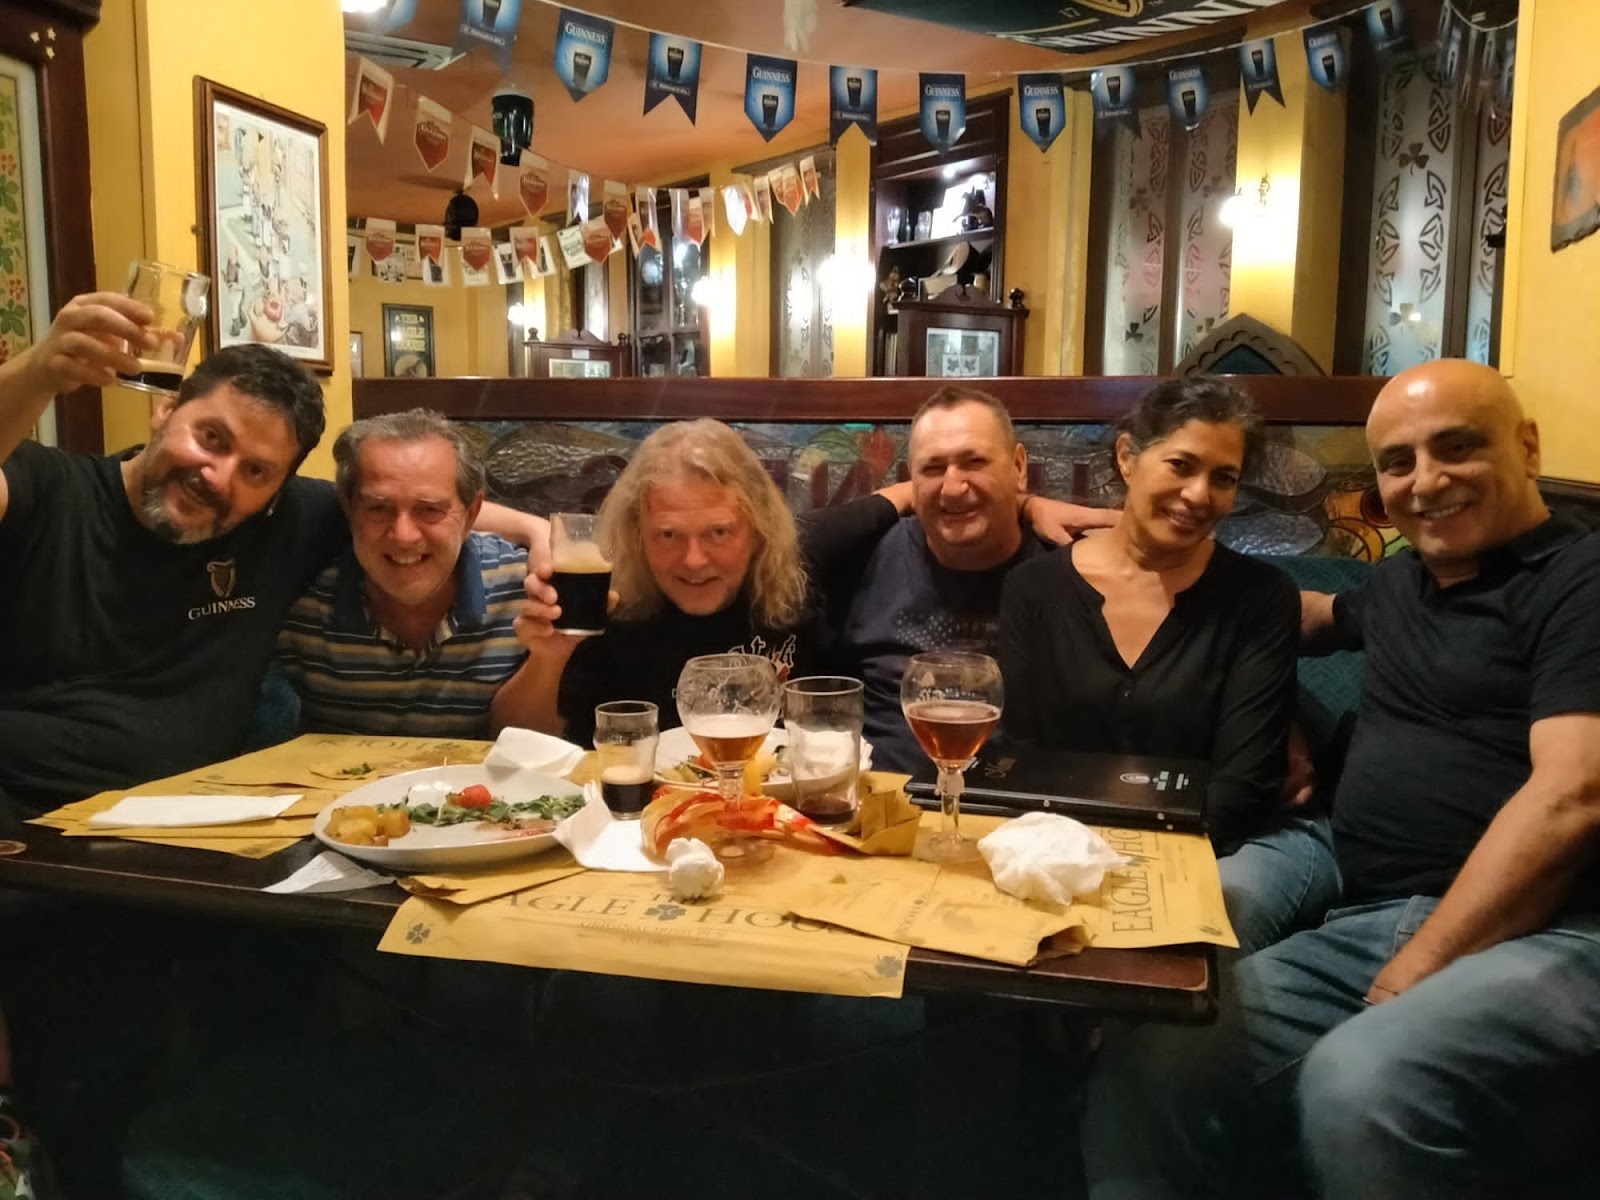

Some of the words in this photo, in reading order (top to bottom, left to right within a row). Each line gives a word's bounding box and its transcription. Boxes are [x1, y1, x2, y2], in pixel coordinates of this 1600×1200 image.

[565, 22, 606, 45] GUINNESS
[752, 66, 791, 83] GUINNESS
[925, 84, 960, 97] GUINNESS
[1024, 85, 1058, 97] GUINNESS
[187, 596, 256, 621] GUINNESS
[504, 893, 636, 916] AGLE
[1112, 871, 1153, 932] EAGLE
